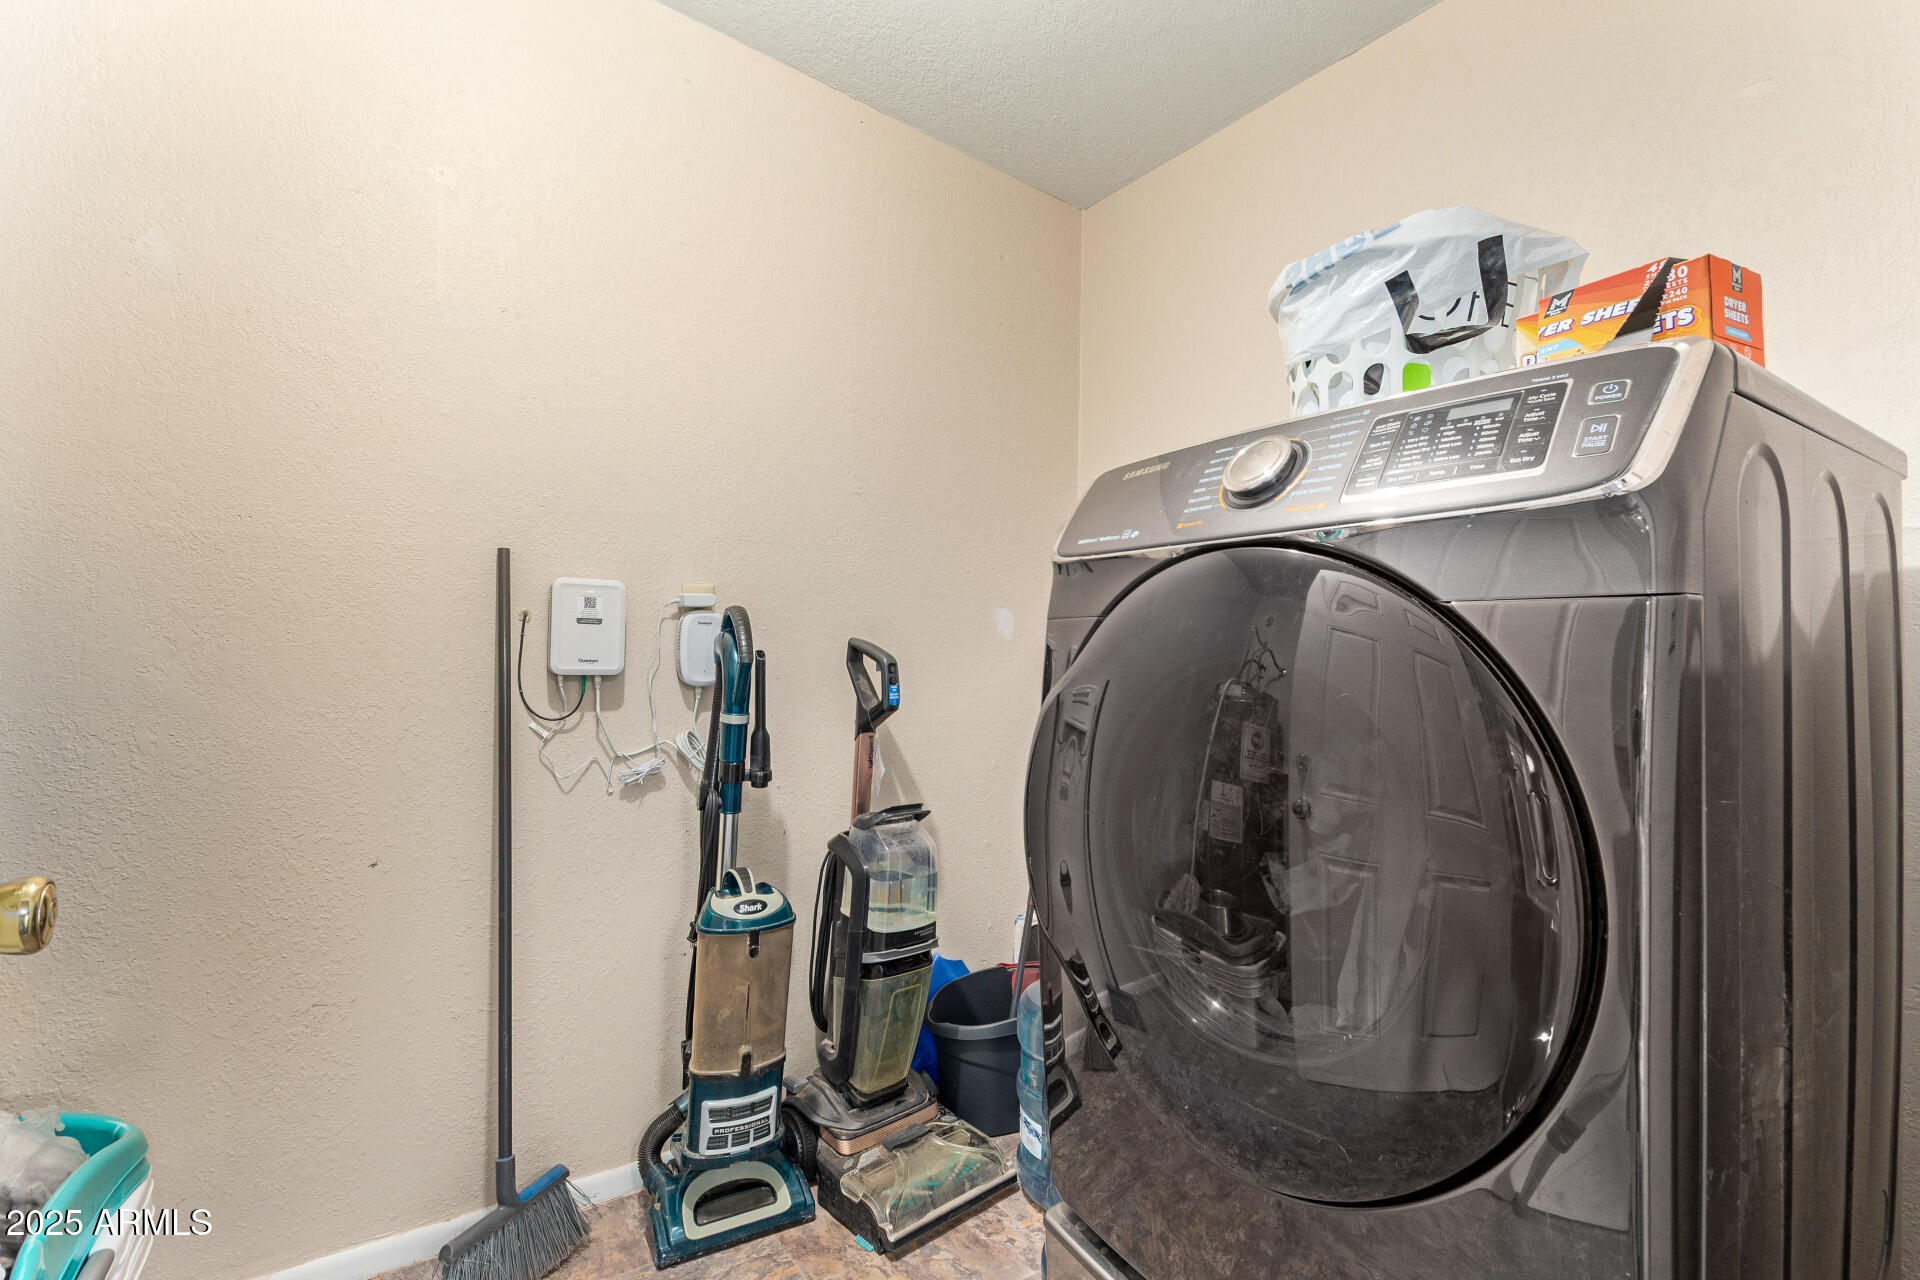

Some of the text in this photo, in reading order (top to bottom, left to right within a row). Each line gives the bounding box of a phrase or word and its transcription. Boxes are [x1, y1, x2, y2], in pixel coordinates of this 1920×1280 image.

[1669, 286, 1688, 298] 240
[1724, 295, 1747, 314] DRYER
[1724, 307, 1750, 326] SHEETS
[1122, 461, 1171, 481] SAMSUNG
[740, 903, 762, 912] Shark
[714, 1118, 769, 1135] PROFESSIONAL
